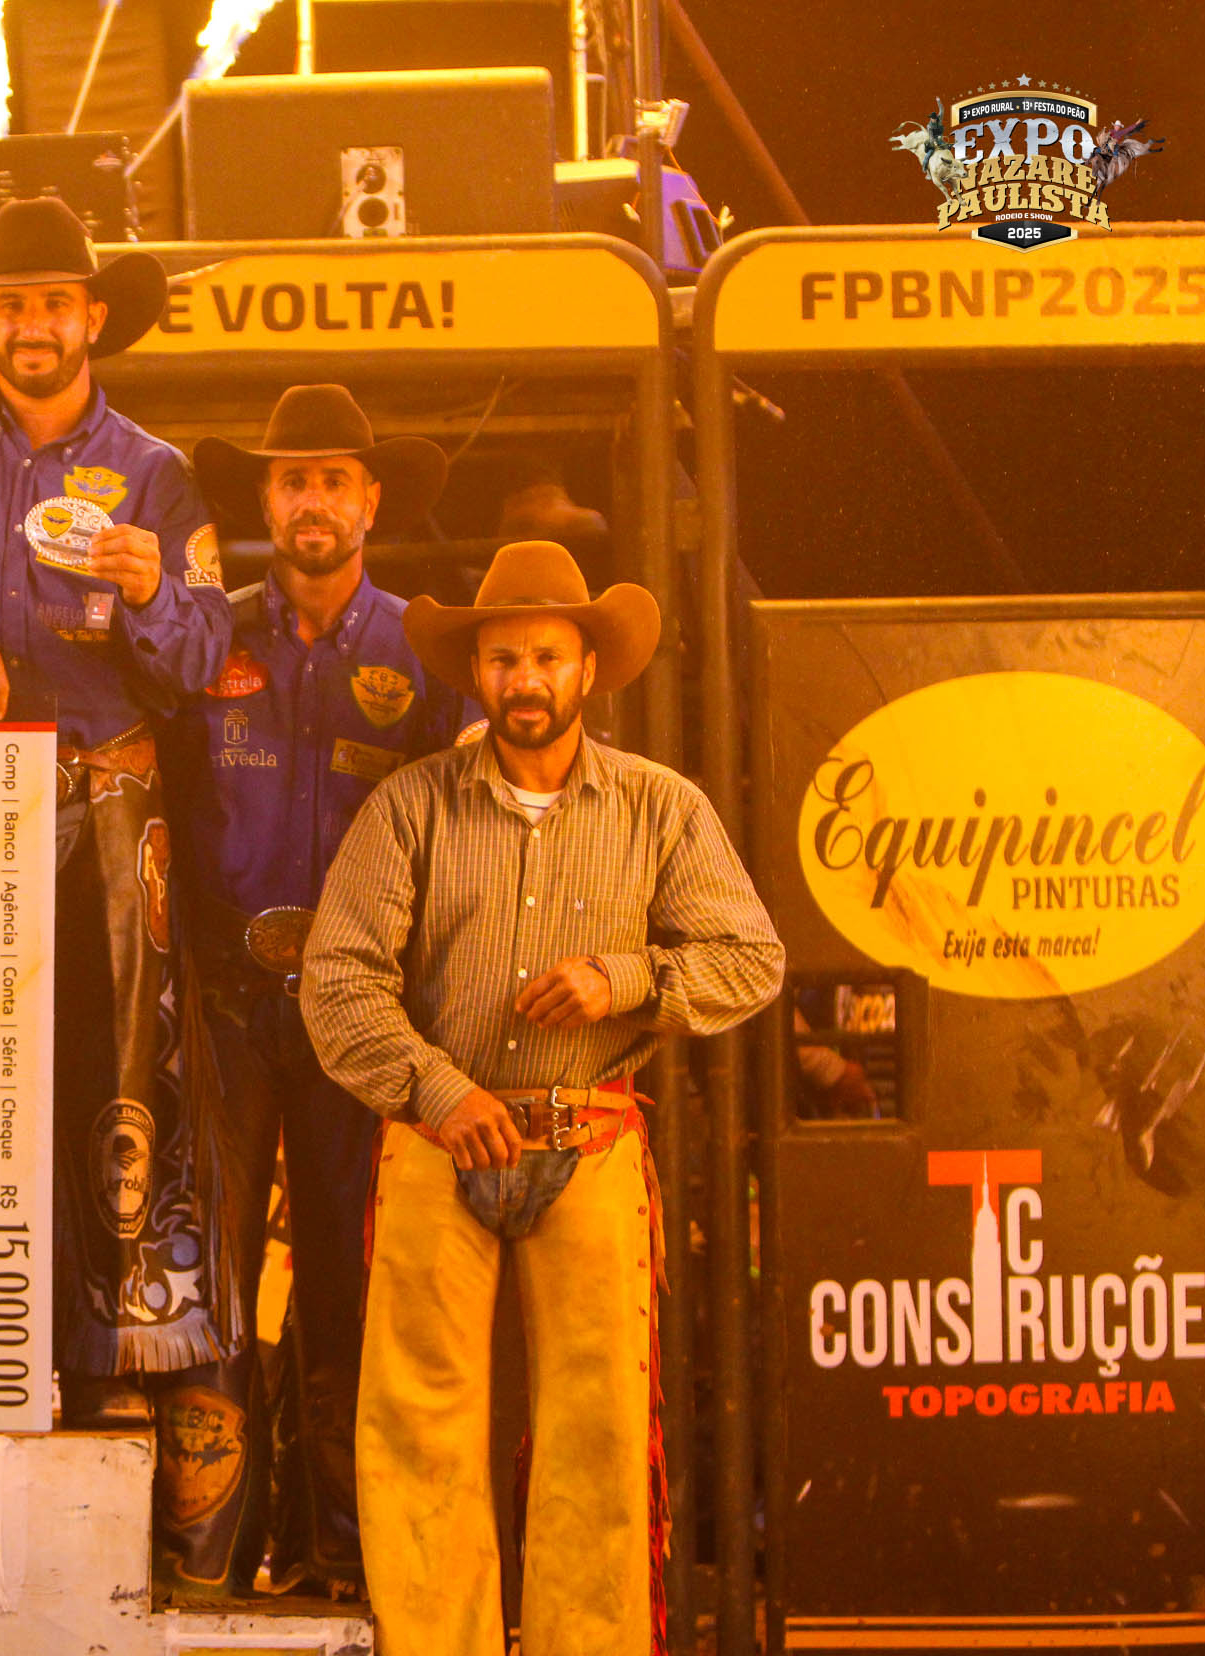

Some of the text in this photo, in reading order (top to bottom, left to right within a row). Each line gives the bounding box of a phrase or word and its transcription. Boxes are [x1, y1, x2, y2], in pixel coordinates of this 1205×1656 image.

[211, 280, 455, 333] VOLTA!
[800, 265, 1205, 320] FPBNP2025
[0, 743, 20, 790] Comp
[4, 811, 19, 861] Banco
[813, 756, 1205, 909] Equipincel
[0, 881, 19, 946] Agência
[1011, 874, 1181, 911] PINTURAS
[943, 928, 1101, 967] Exija esta marca!
[2, 966, 18, 1015] Conta
[1, 1036, 18, 1077] Série
[0, 1098, 17, 1160] Cheque
[0, 1184, 17, 1209] R$
[882, 1380, 1176, 1418] TOPOGRAFIA
